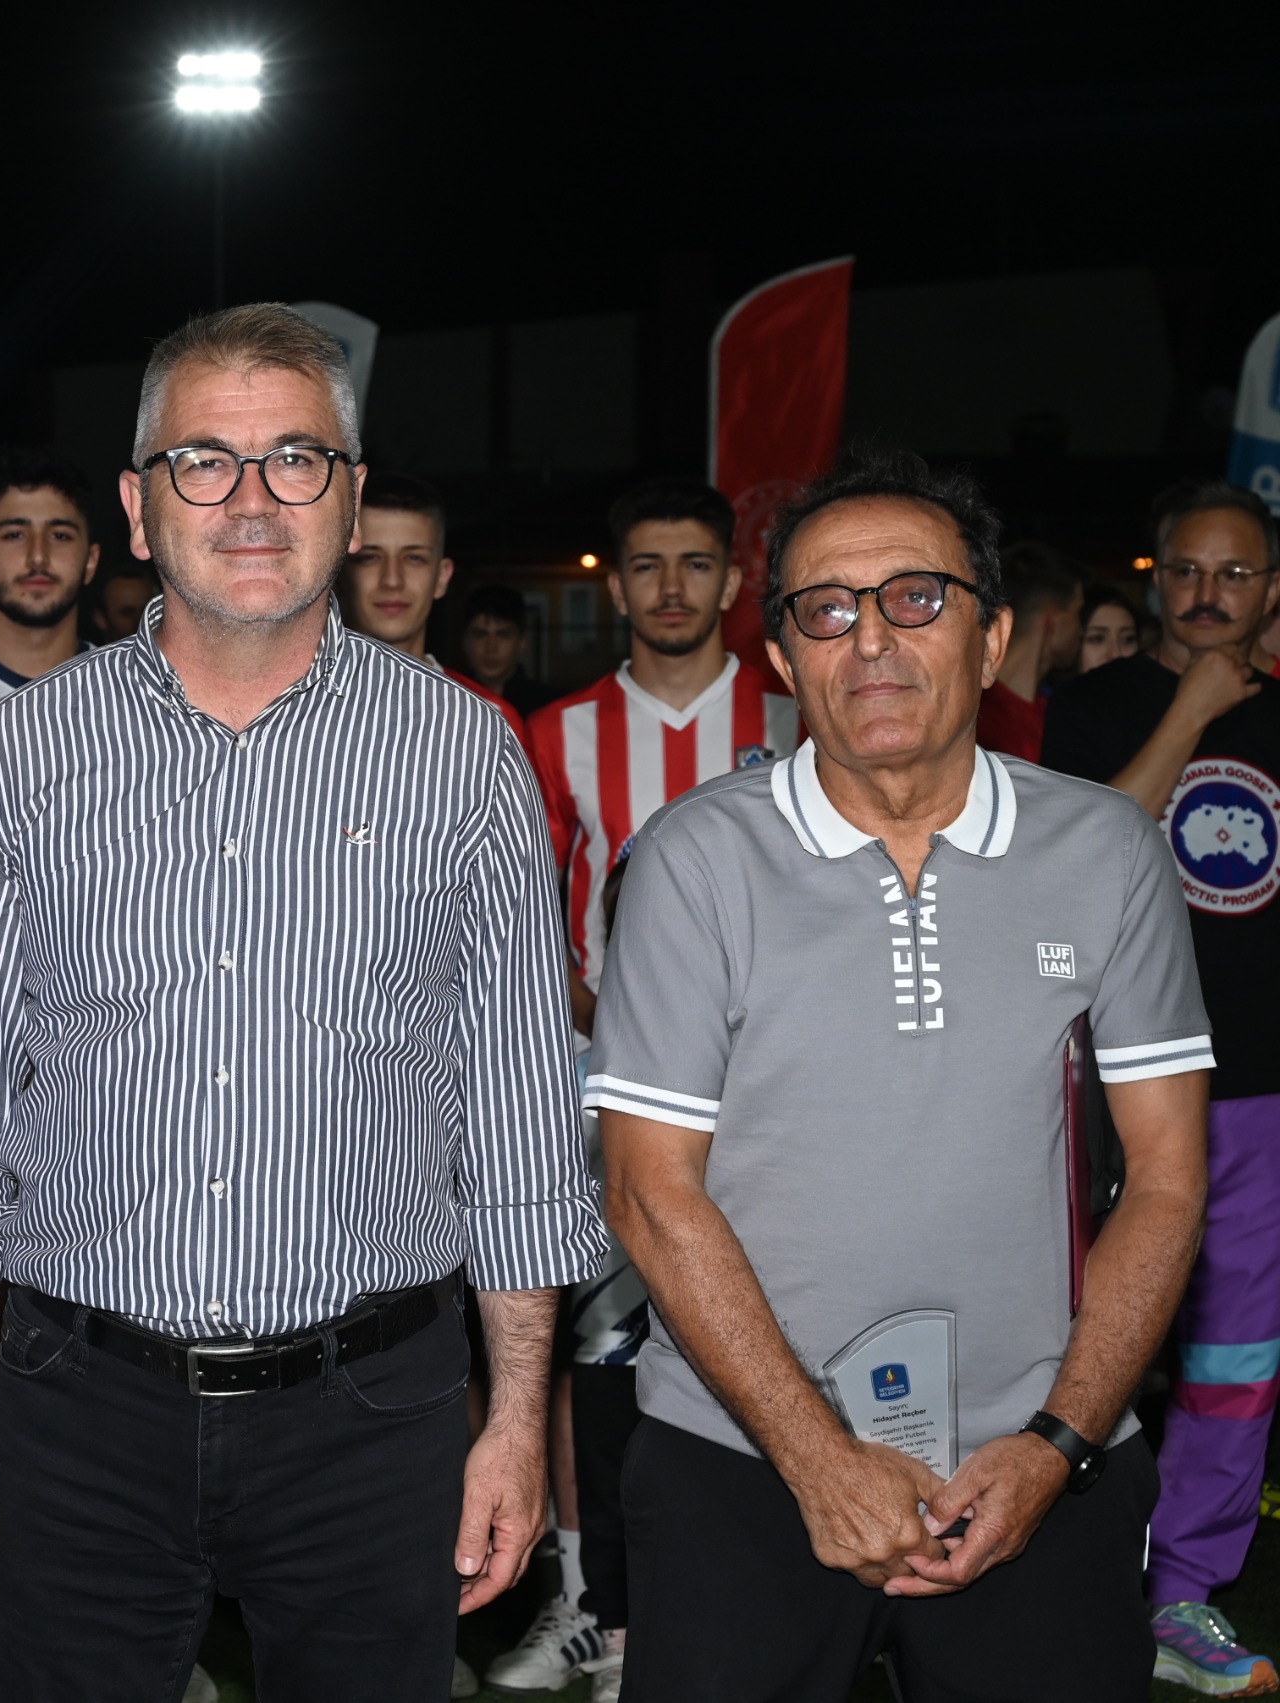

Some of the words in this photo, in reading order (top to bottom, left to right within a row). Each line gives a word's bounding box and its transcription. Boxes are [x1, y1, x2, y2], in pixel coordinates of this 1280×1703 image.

[1179, 765, 1222, 787] CANADA
[1222, 878, 1275, 906] PROGRAM
[1040, 946, 1070, 960] LUF
[1043, 960, 1071, 975] IAN
[873, 1414, 900, 1424] Hidayet
[901, 1408, 927, 1418] Reçber
[905, 1430, 926, 1439] Futbol
